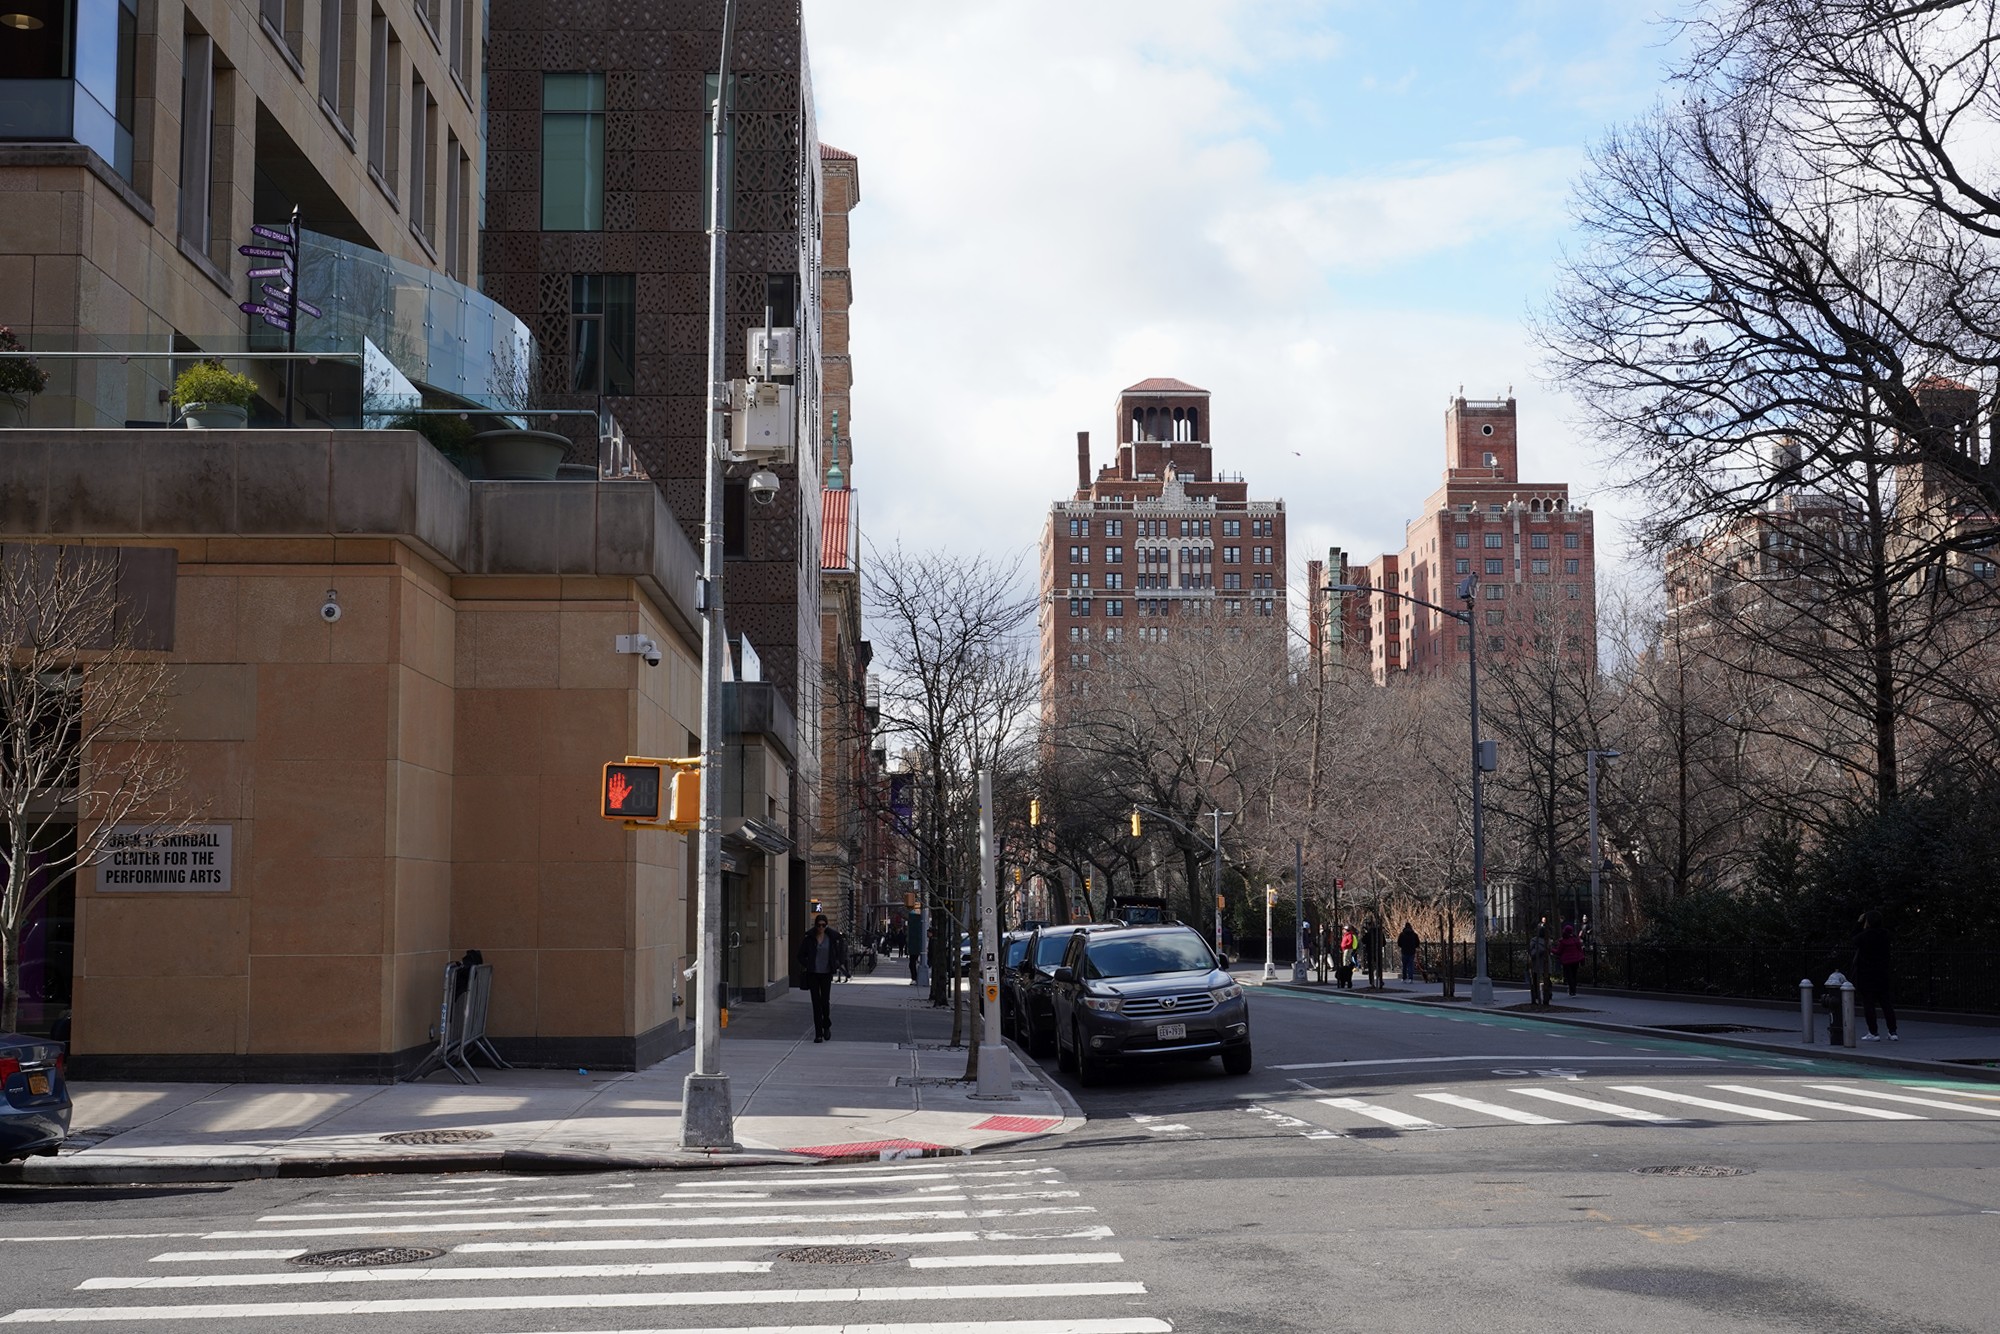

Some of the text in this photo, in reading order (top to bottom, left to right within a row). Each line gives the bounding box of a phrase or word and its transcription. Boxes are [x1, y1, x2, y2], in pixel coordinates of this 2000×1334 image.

[260, 229, 290, 242] ABU DHABI
[249, 248, 271, 256] BUENOS
[268, 286, 289, 302] FLORENCE
[273, 302, 287, 314] MADRID
[298, 300, 317, 315] SHANGHAI
[270, 316, 287, 328] TEL AVIV
[161, 833, 220, 847] SKIRBALL
[114, 851, 215, 866] CENTER FOR THE
[106, 869, 221, 884] PERFORMING ARTS
